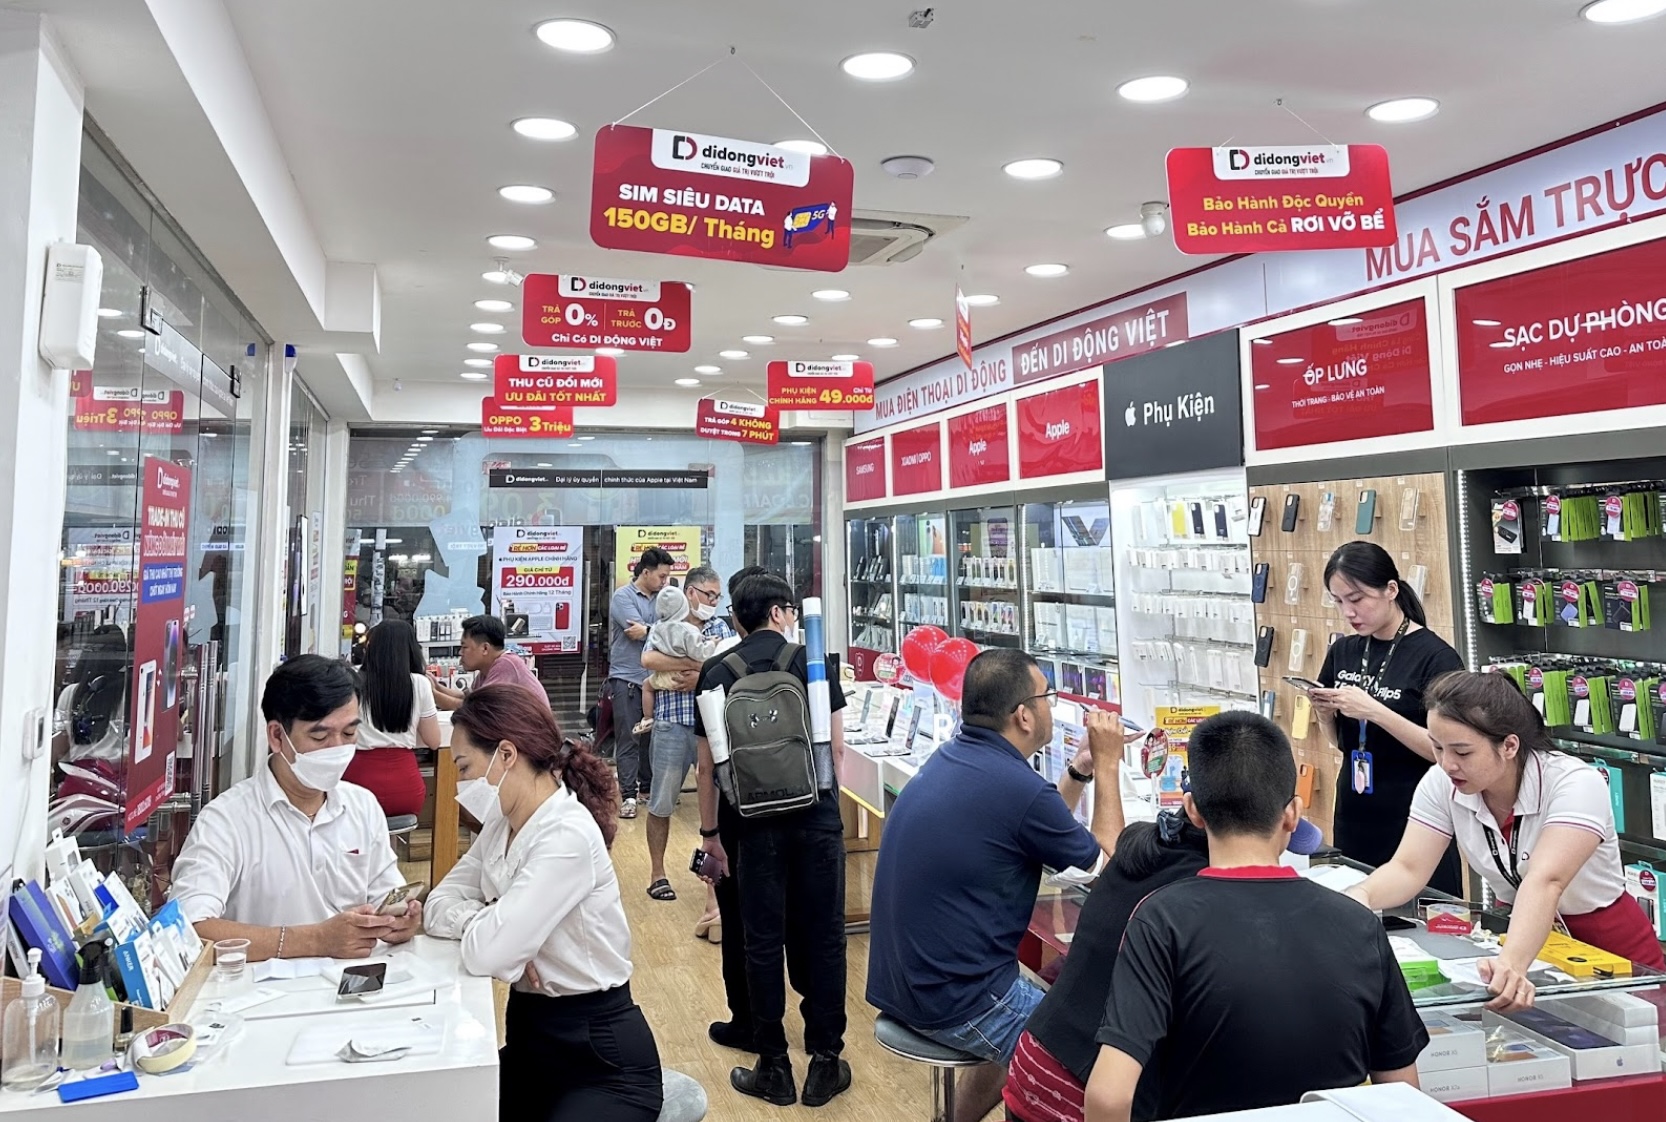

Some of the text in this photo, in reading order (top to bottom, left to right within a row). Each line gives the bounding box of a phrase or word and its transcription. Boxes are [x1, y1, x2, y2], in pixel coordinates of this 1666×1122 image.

[619, 184, 766, 216] SIM SIÊU DATA
[1203, 191, 1364, 212] Bảo Hành Độc Quyền
[812, 210, 826, 221] 5G
[1187, 208, 1385, 237] Bảo Hành Cả RƠI VỠ BỂ
[1366, 153, 1666, 282] MUA SẮM TRỰC
[603, 207, 775, 249] 150GB/ Tháng
[542, 303, 561, 314] TRẢ
[564, 302, 599, 327] 0%
[618, 308, 636, 318] TRẢ
[541, 315, 562, 325] GÓP
[611, 317, 642, 329] TRƯỚC
[644, 307, 676, 331] 0Đ
[1504, 298, 1666, 352] SẠC DỰ PHÒNG
[552, 333, 663, 349] Chỉ Có DI ĐỘNG VIỆT
[1020, 307, 1170, 376] ĐẾN DI ĐỘNG VIỆT
[1504, 362, 1523, 375] GỌN
[1524, 358, 1543, 371] NHẸ
[1549, 353, 1571, 367] HIỆU
[1572, 347, 1598, 363] SUẤT
[1600, 346, 1621, 359] CAO
[1629, 343, 1644, 354] AN
[1304, 362, 1324, 386] ỐP
[1327, 358, 1368, 383] LƯNG
[508, 375, 603, 388] THU CŨ ĐỔI MỚI
[875, 359, 1007, 422] MUA ĐIỆN THOẠI DI ĐỘNG
[505, 390, 607, 402] ƯU ĐÃI TỐT NHẤT
[782, 386, 817, 396] PHỤ KIỆN
[1306, 395, 1328, 407] TRANG
[1331, 390, 1345, 403] BẢO
[1345, 388, 1355, 402] VỆ
[1355, 388, 1365, 399] AN
[1366, 384, 1385, 397] TOÀN
[769, 396, 794, 405] CHÍNH
[1143, 392, 1215, 426] Phụ Kiện
[489, 416, 522, 425] OPPO
[530, 416, 571, 434] 3 Triệu
[704, 416, 717, 424] TRẢ
[730, 418, 738, 426] 4
[738, 418, 772, 430] KHÔNG
[742, 430, 748, 438] 7
[749, 430, 775, 441] PHÚT
[1045, 421, 1071, 440] Apple
[968, 438, 988, 456] Apple
[506, 574, 570, 588] 290.000đ
